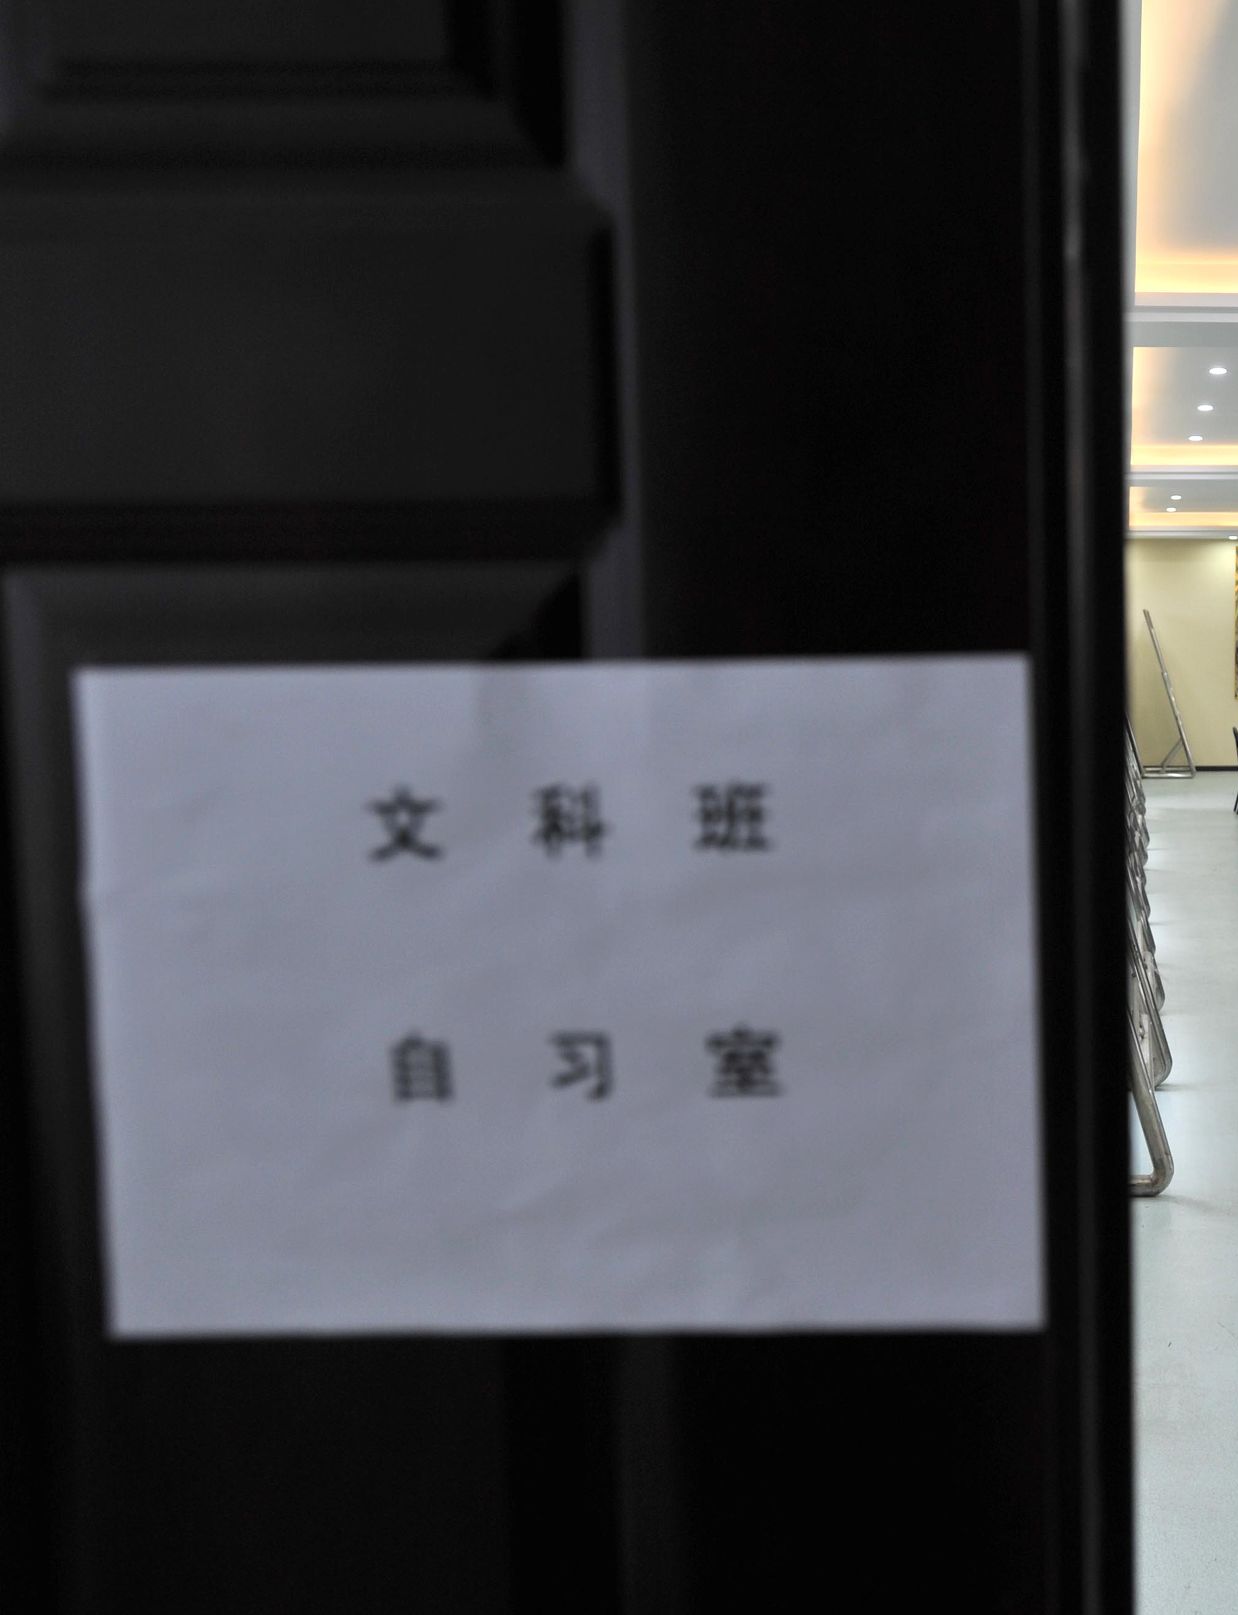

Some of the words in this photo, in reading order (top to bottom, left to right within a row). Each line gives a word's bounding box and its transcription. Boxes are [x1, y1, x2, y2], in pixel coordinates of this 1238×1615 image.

[367, 782, 773, 862] 文科班
[391, 1023, 782, 1103] 自习室
